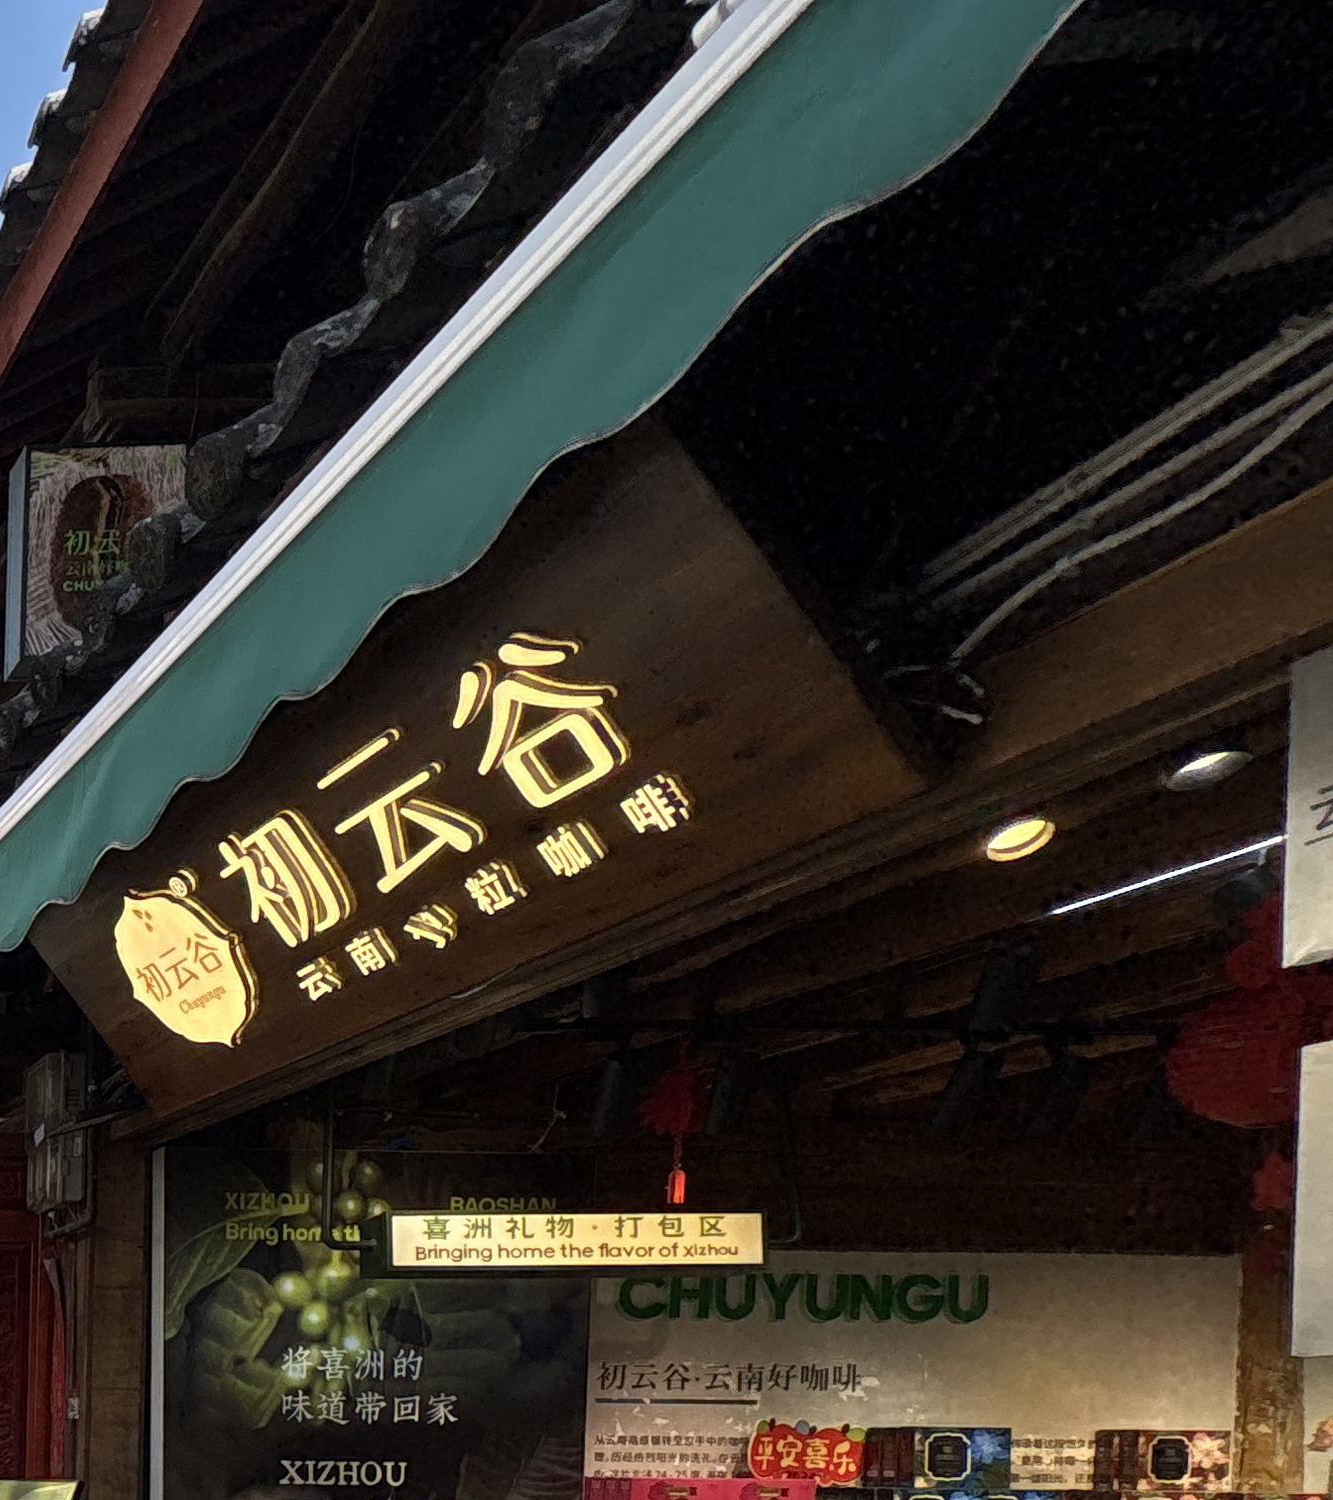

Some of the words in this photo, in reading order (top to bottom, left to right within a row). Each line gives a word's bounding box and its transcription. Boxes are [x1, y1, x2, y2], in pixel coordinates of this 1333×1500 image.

[62, 579, 103, 592] CHU
[219, 631, 630, 948] 初云谷
[136, 932, 223, 1002] 初云谷
[225, 1222, 278, 1246] Bring
[415, 1246, 493, 1262] Bringing
[498, 1245, 556, 1260] home
[560, 1243, 595, 1259] the
[599, 1242, 655, 1258] flavor
[659, 1242, 680, 1258] of
[617, 1272, 991, 1324] CHUYUNGU
[281, 1345, 423, 1381] 将喜洲的
[282, 1389, 460, 1427] 味道带回家
[279, 1459, 408, 1487] XIZHOU
[753, 1436, 858, 1476] 平安喜乐
